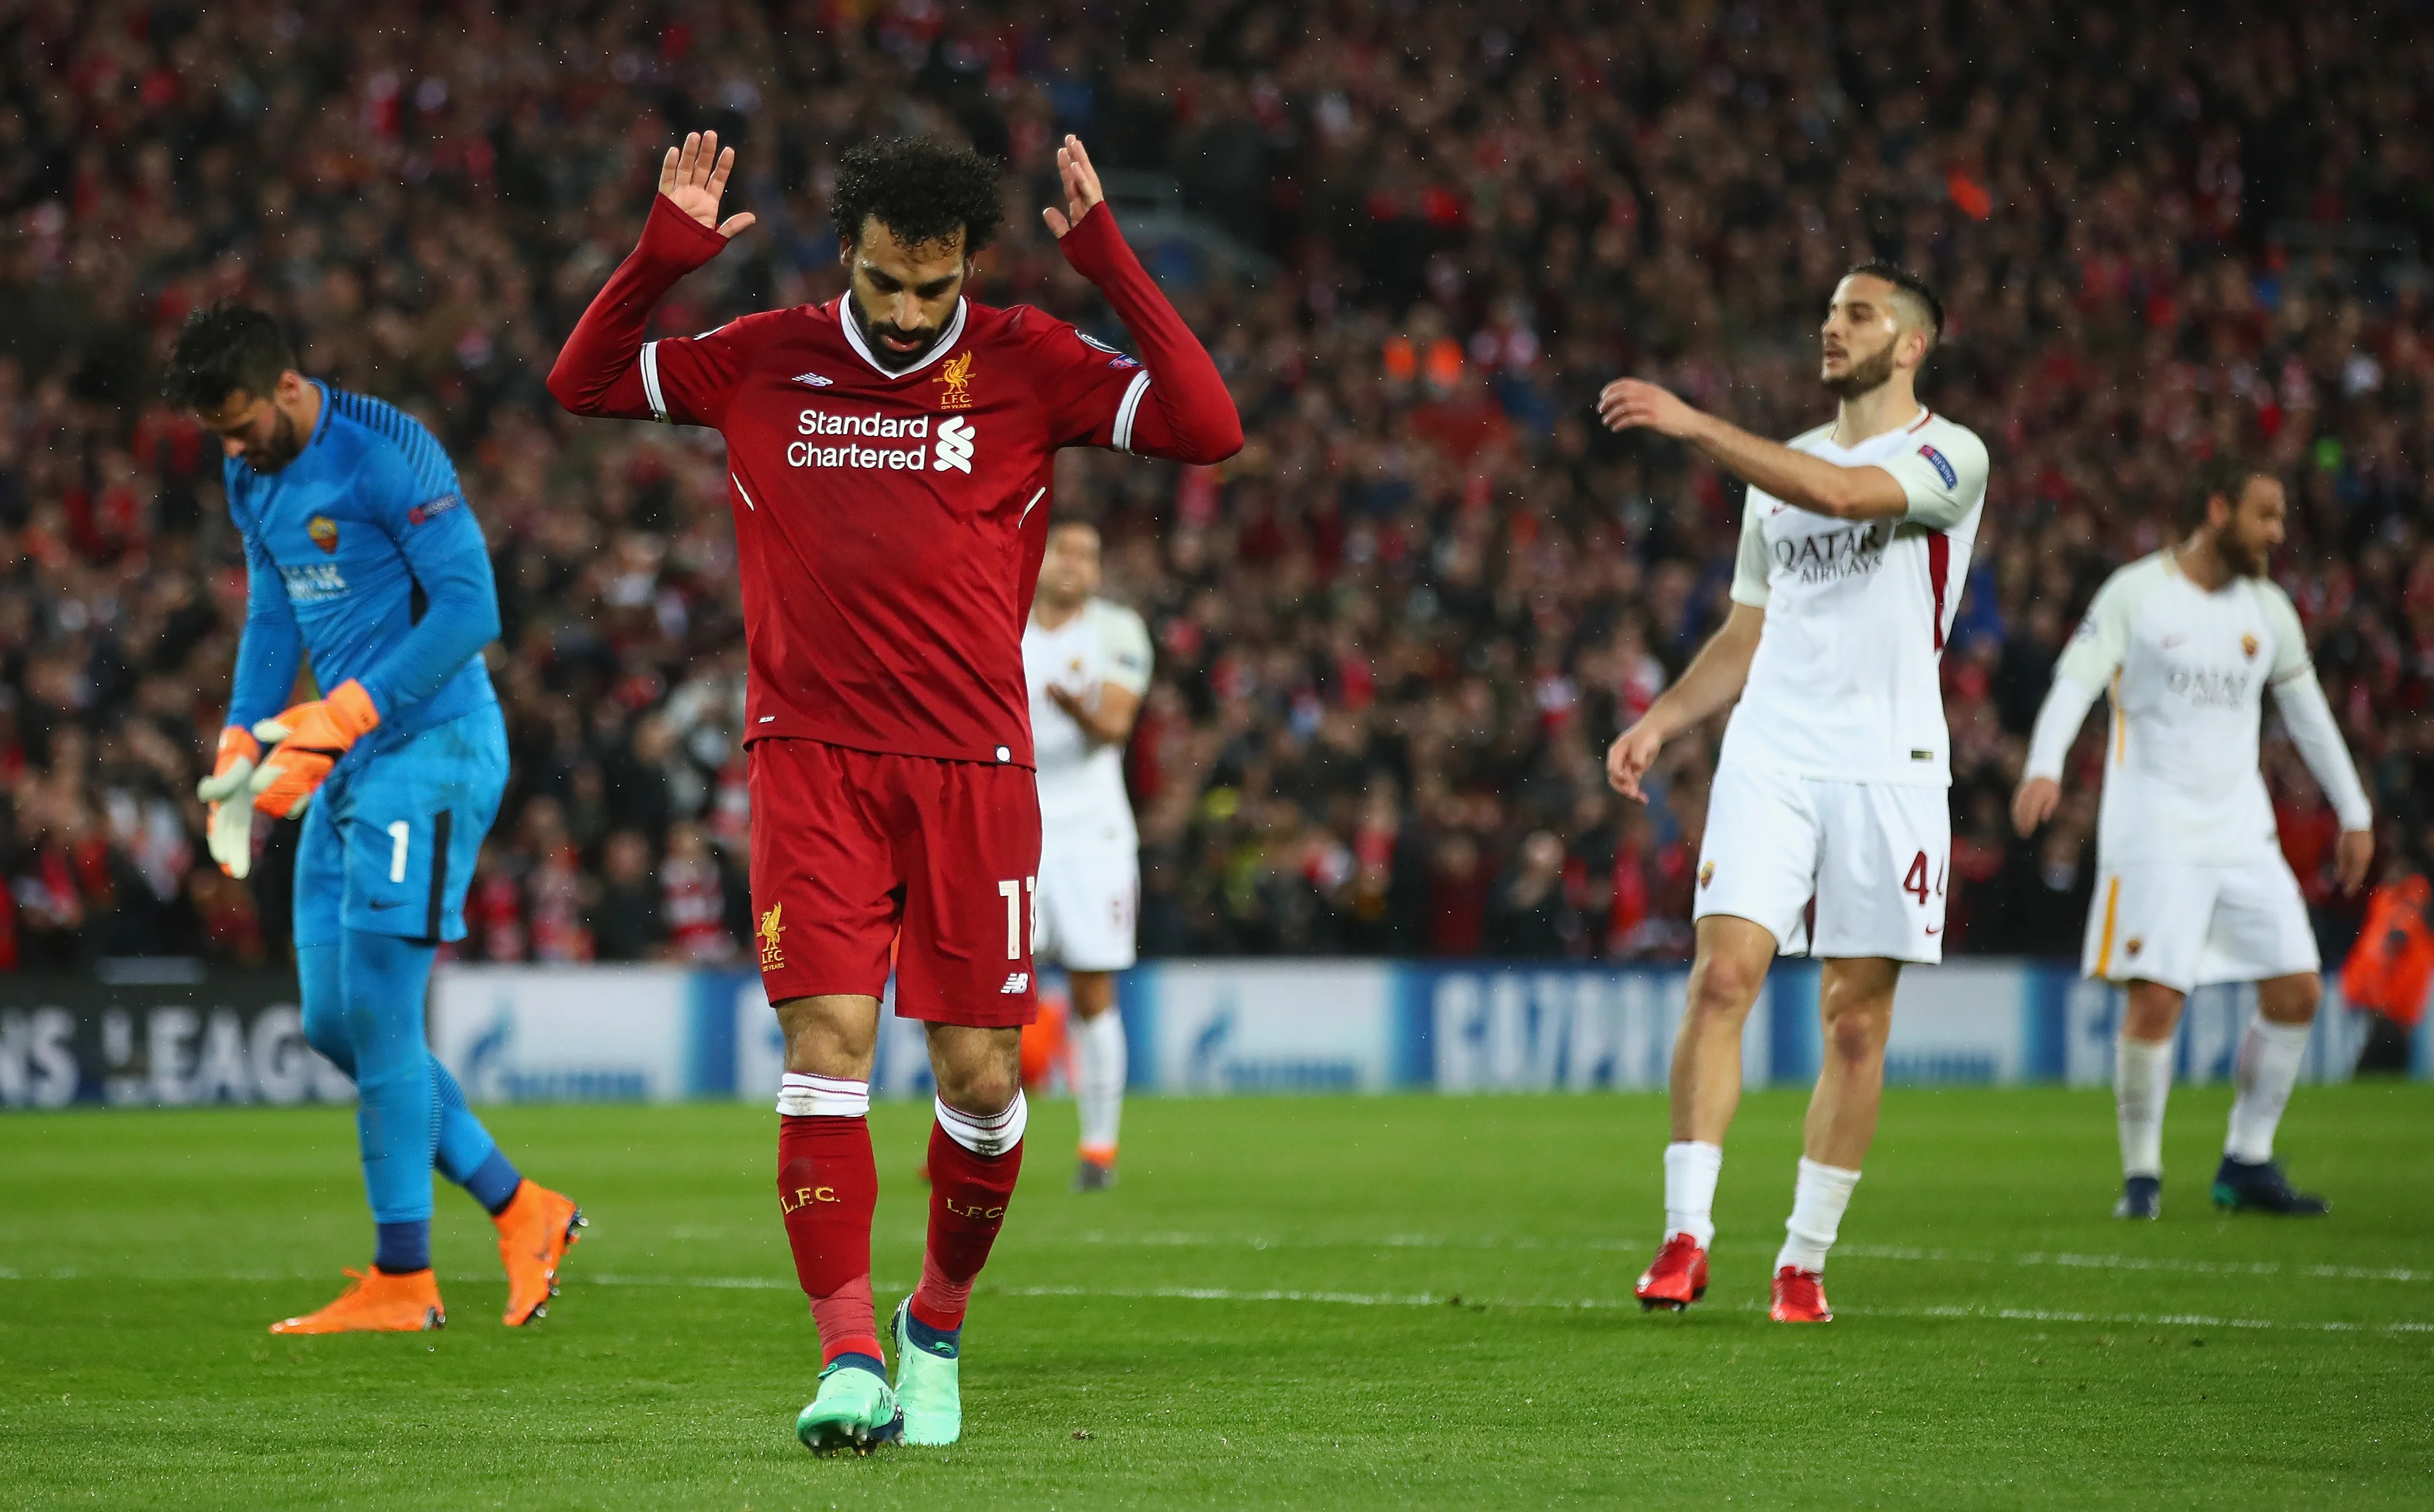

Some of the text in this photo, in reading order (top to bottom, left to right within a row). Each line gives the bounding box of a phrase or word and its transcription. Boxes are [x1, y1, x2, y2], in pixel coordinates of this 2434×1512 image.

[941, 394, 973, 404] L.F.C.
[798, 410, 929, 438] Standard
[787, 442, 926, 470] Chartered
[1776, 525, 1881, 572] QATAR
[1801, 557, 1883, 584] AIRWAYS
[387, 820, 409, 883] 1
[762, 950, 784, 964] L.F.C.
[781, 1187, 841, 1215] L.F.C.
[947, 1199, 1003, 1218] L.F.C.
